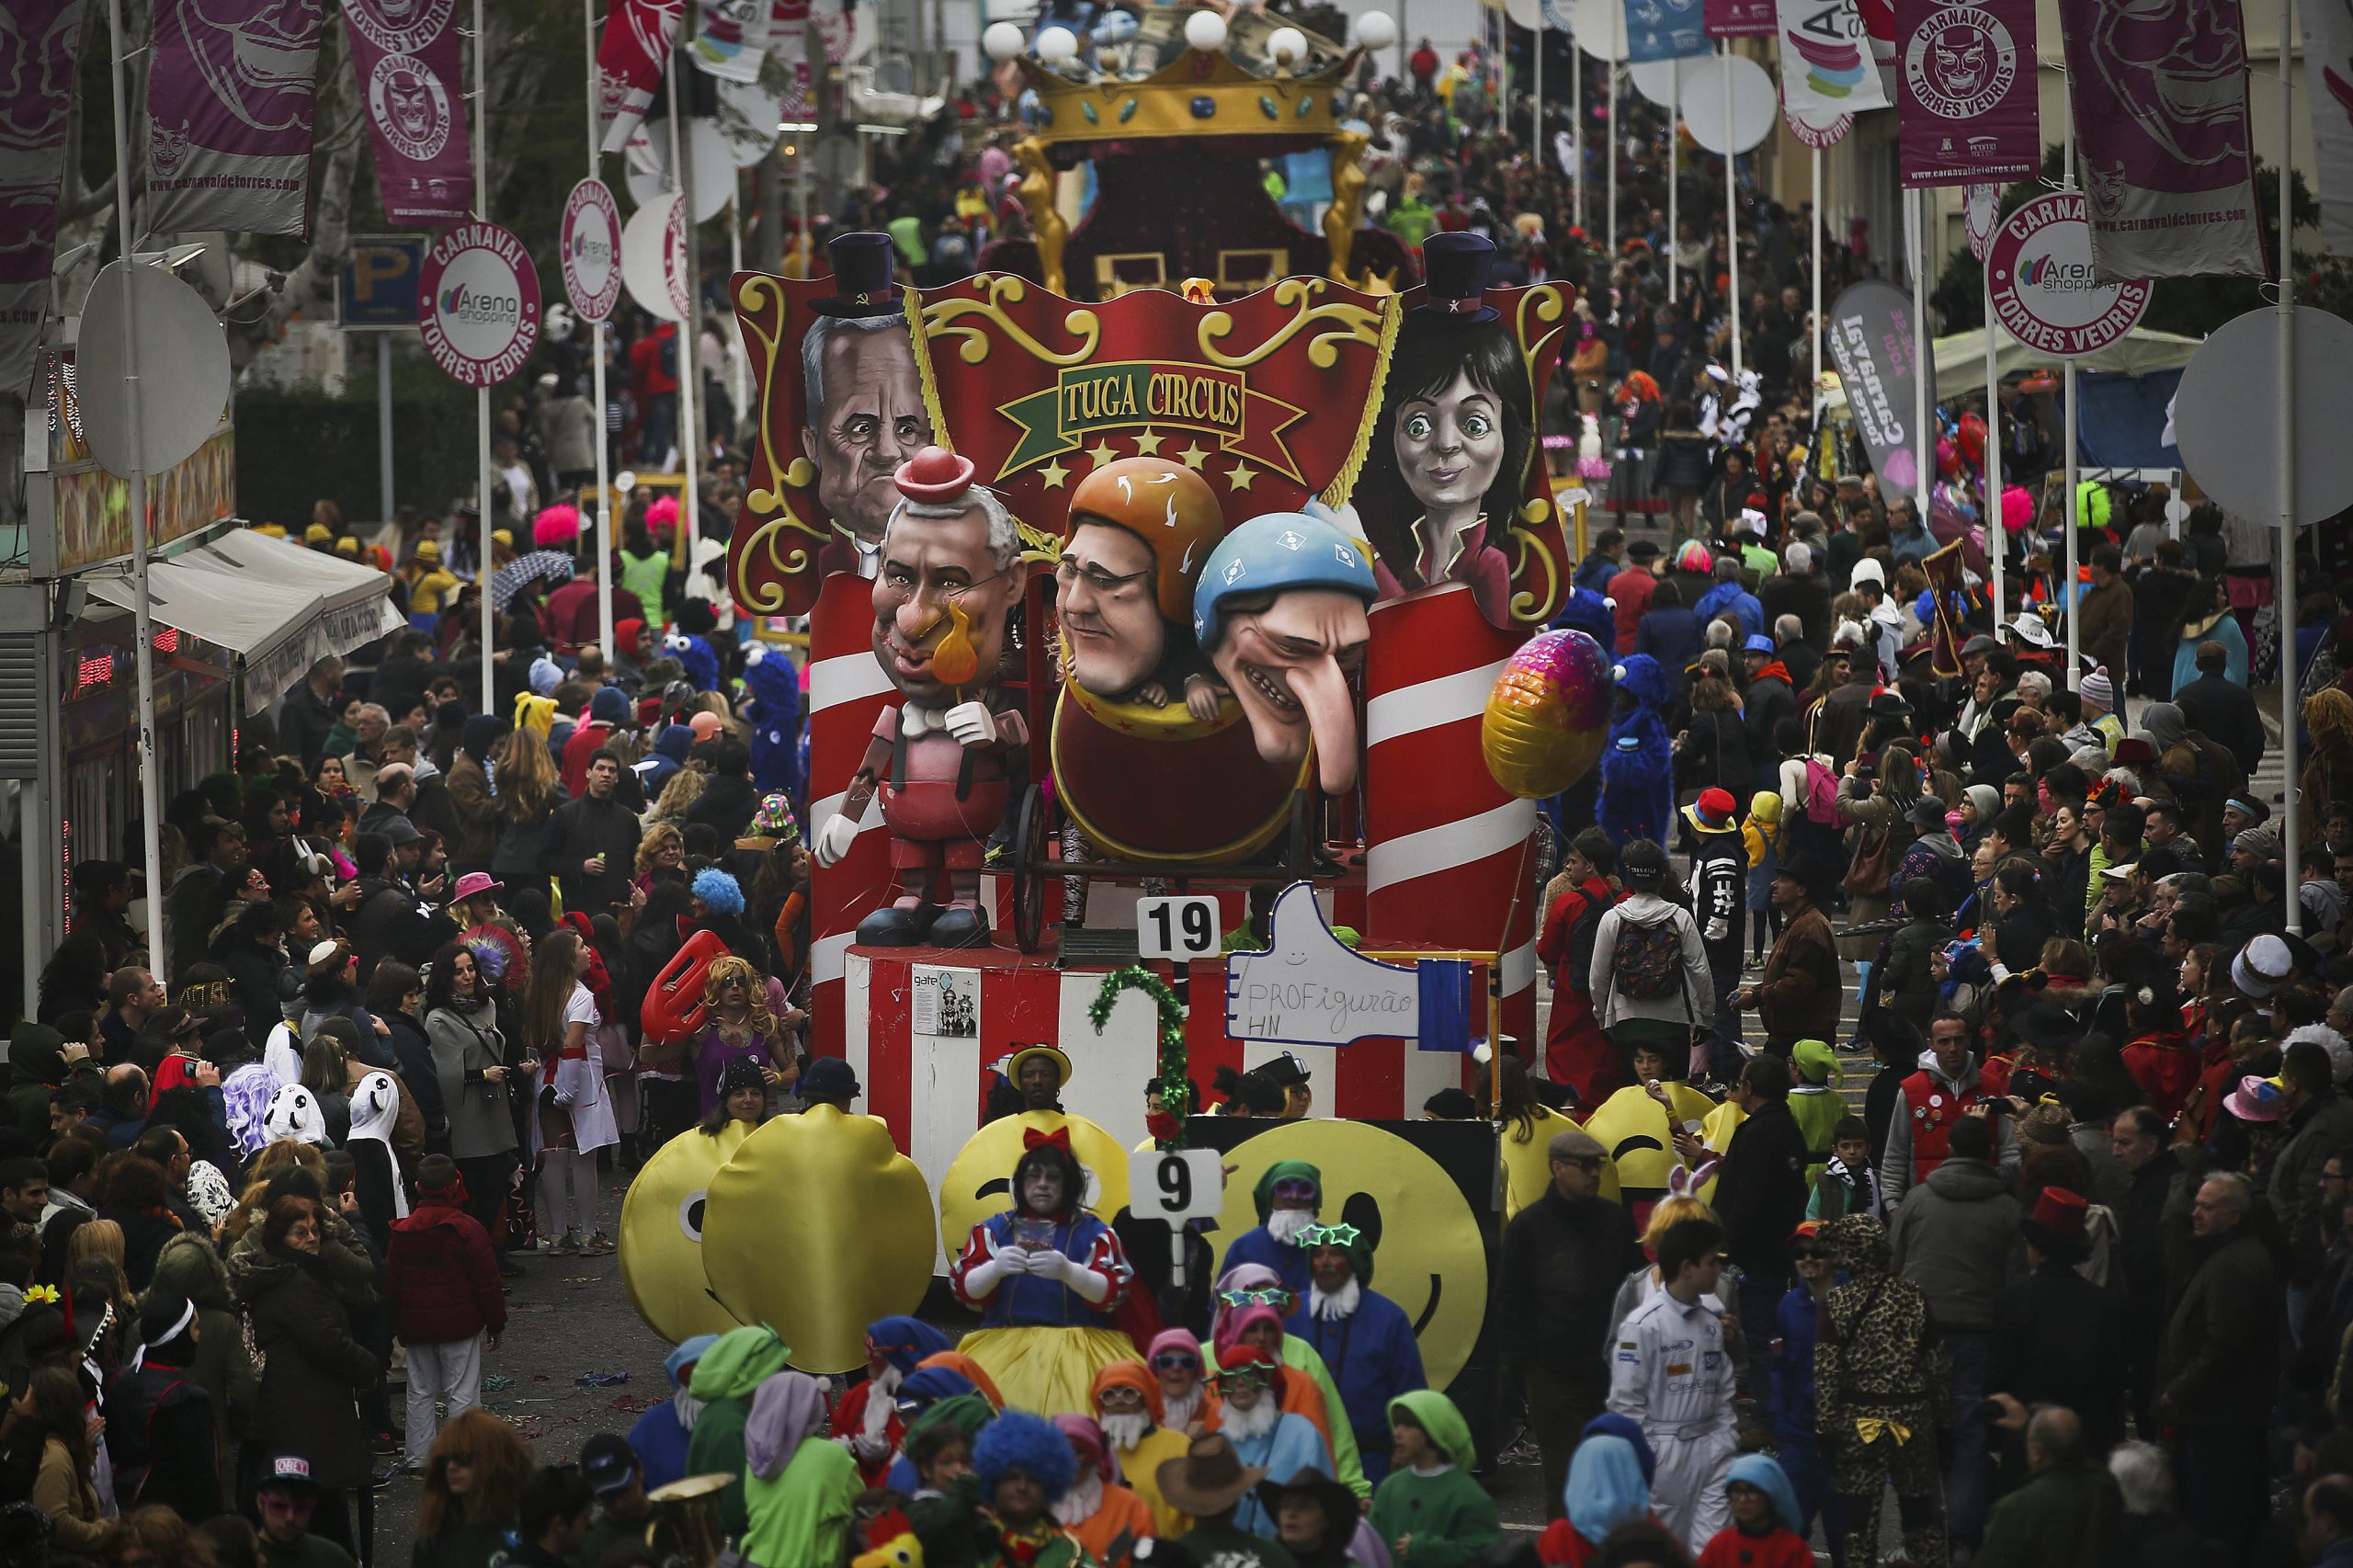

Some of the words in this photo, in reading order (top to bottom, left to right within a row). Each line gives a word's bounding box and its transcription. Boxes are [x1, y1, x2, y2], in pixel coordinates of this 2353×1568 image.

[404, 0, 450, 49] VEDRA
[1917, 8, 1997, 42] CARNAVAL
[374, 56, 429, 83] CARNAVAL
[1911, 74, 1961, 117] TORRES
[1964, 65, 2013, 116] VEDRAS
[150, 173, 300, 192] www.carnavaldetorres.com
[1911, 164, 2029, 180] www.carnavaldetorres.com
[2008, 198, 2086, 241] CARNA
[432, 224, 524, 271] CARNAVAL
[355, 246, 410, 301] P
[459, 290, 517, 312] Arena
[460, 310, 517, 327] shopping
[1994, 286, 2066, 351] TORRES
[2070, 284, 2144, 351] VEDRAS
[421, 313, 476, 384] TORRES
[480, 318, 536, 384] VEDRAS
[1063, 373, 1140, 423] TUGA
[1146, 371, 1241, 426] CIRCUS
[1148, 901, 1212, 952] 19
[914, 974, 938, 987] gate
[1247, 1014, 1281, 1037] HN
[1157, 1155, 1192, 1213] 9
